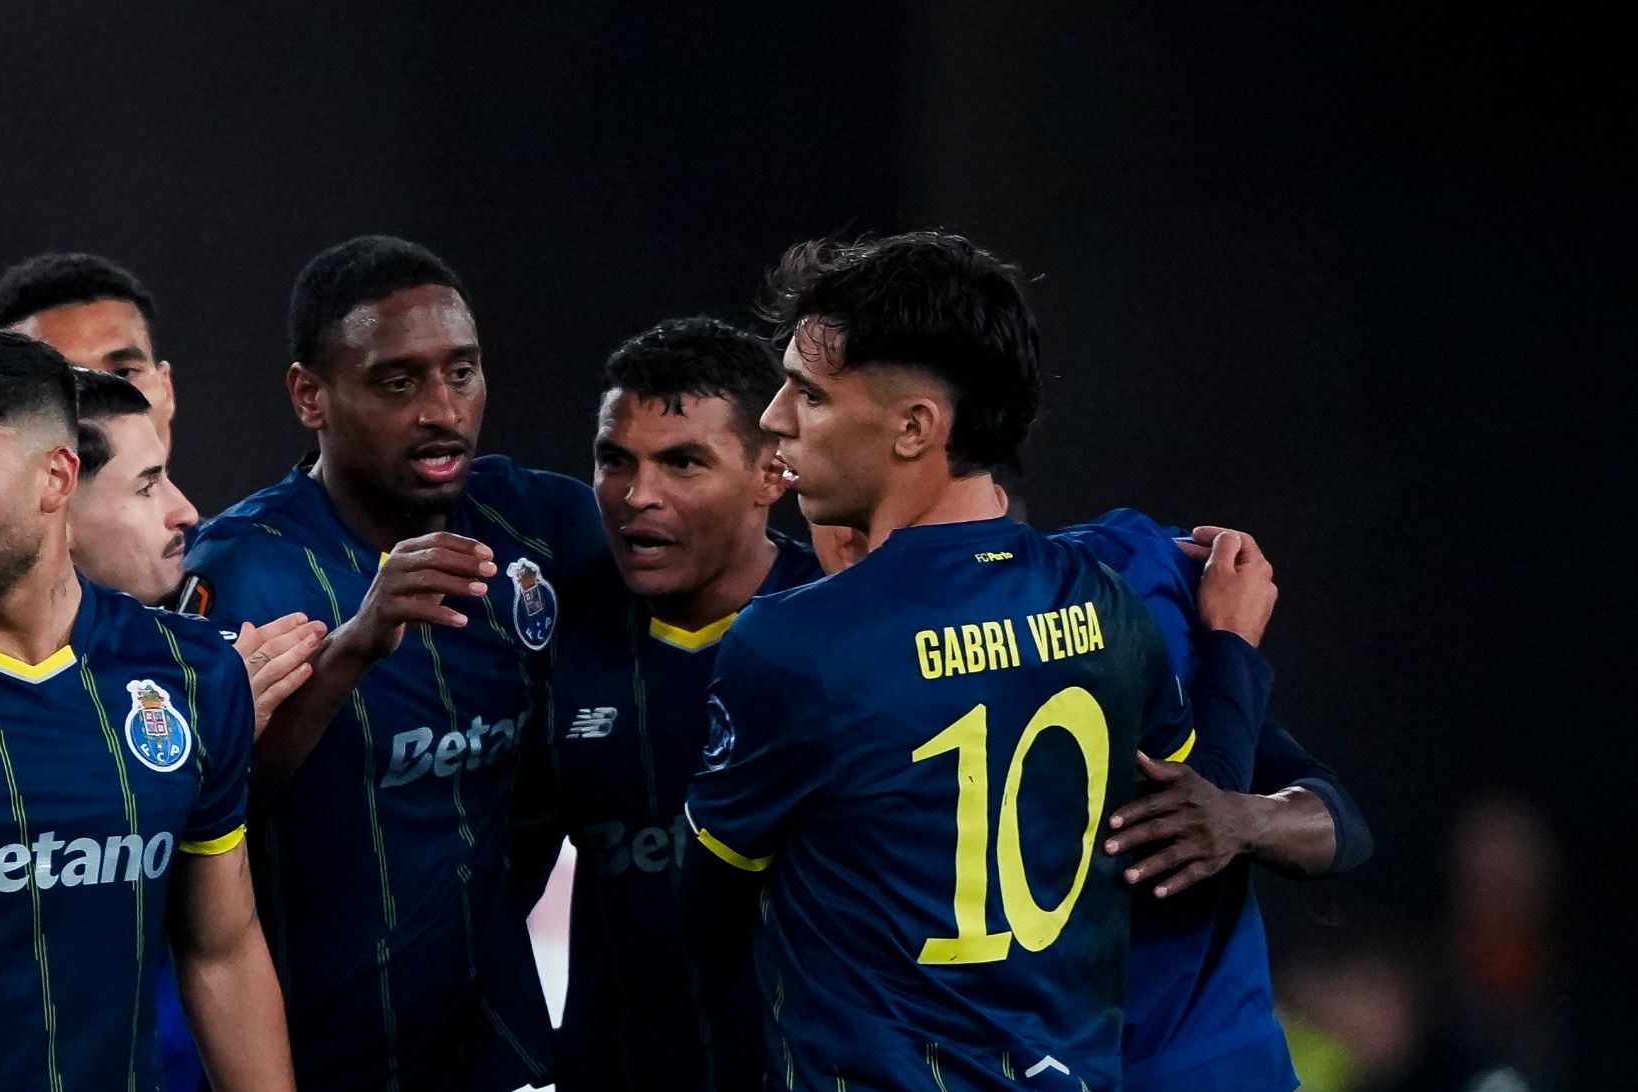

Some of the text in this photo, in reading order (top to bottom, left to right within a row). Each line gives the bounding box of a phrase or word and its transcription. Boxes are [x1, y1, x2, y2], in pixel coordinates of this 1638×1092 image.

[914, 600, 1105, 681] GABRI VEIGA
[380, 703, 532, 789] Beta
[911, 685, 1110, 966] 10
